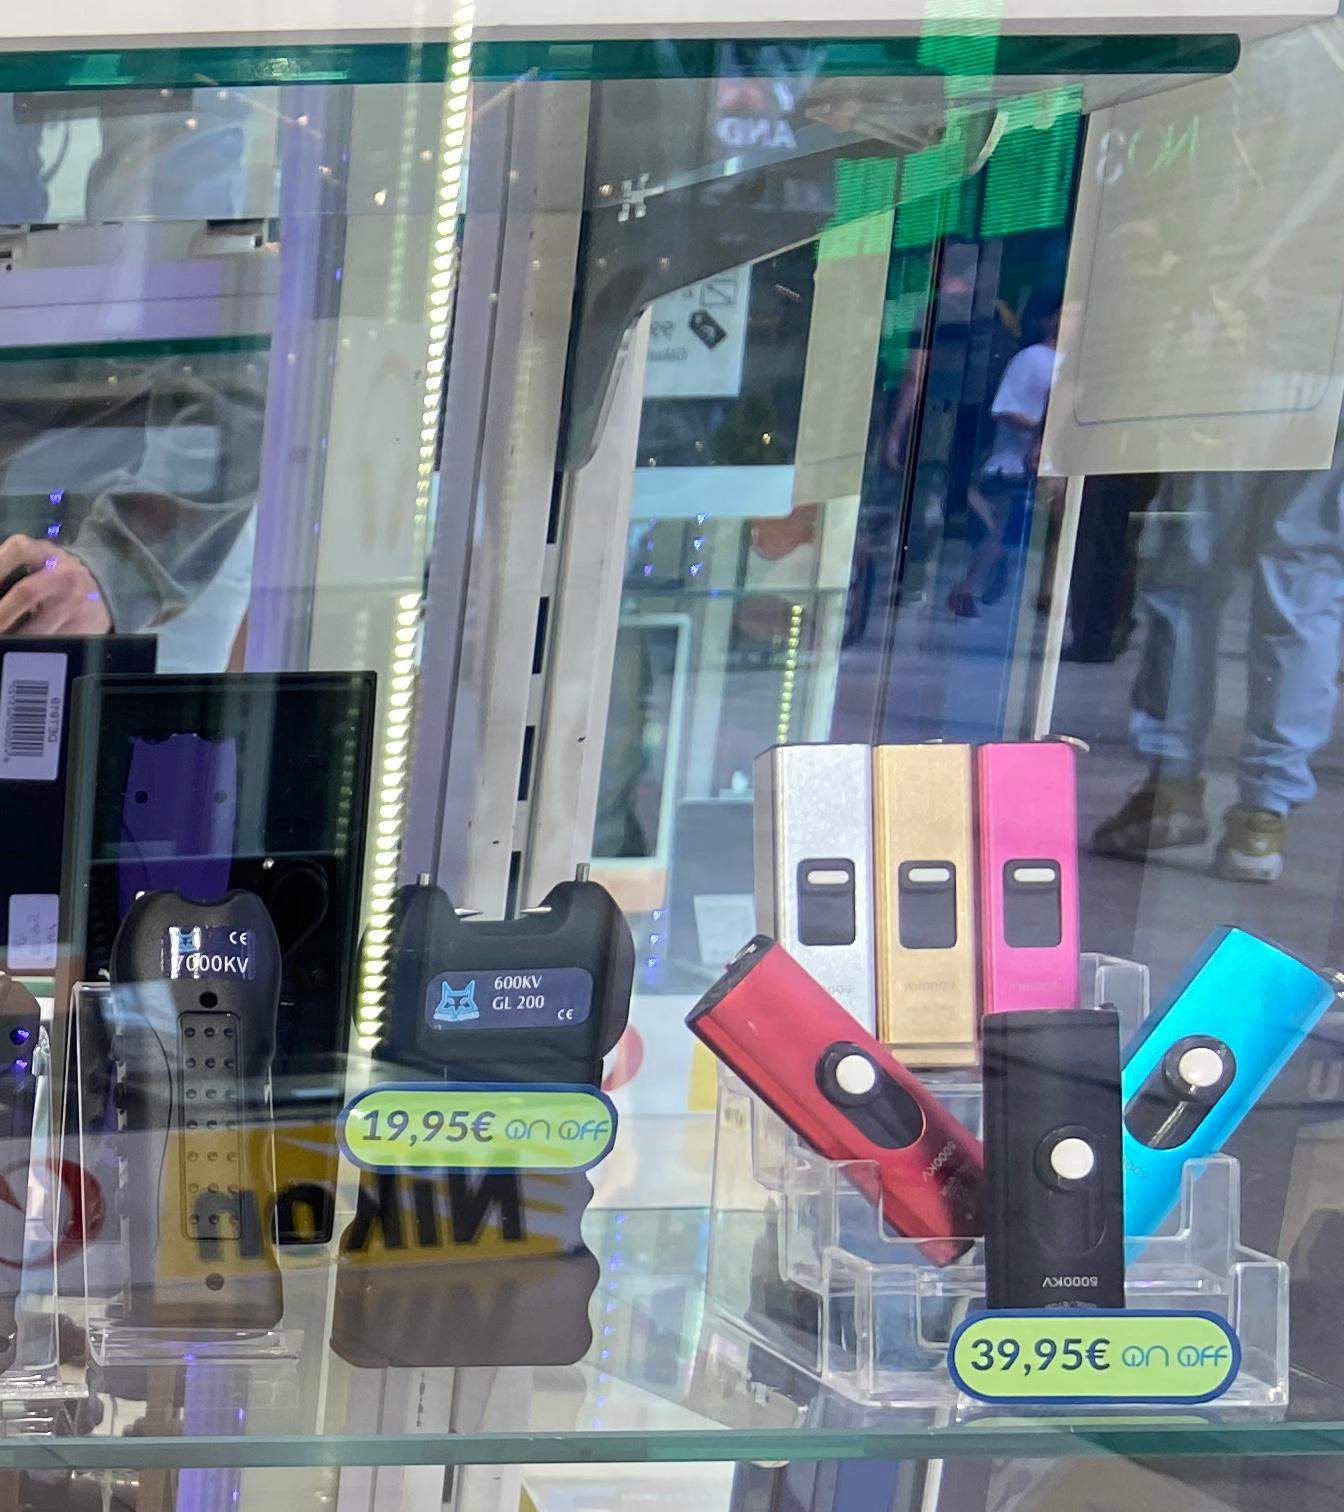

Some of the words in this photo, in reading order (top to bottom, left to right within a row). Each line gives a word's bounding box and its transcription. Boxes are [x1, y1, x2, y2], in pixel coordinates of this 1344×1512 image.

[494, 975, 543, 990] 600KV
[492, 996, 513, 1011] GL
[517, 994, 545, 1010] 200
[361, 1110, 497, 1148] 19,95€
[1042, 1277, 1098, 1288] 5000KV
[971, 1338, 1111, 1377] 39,95€
